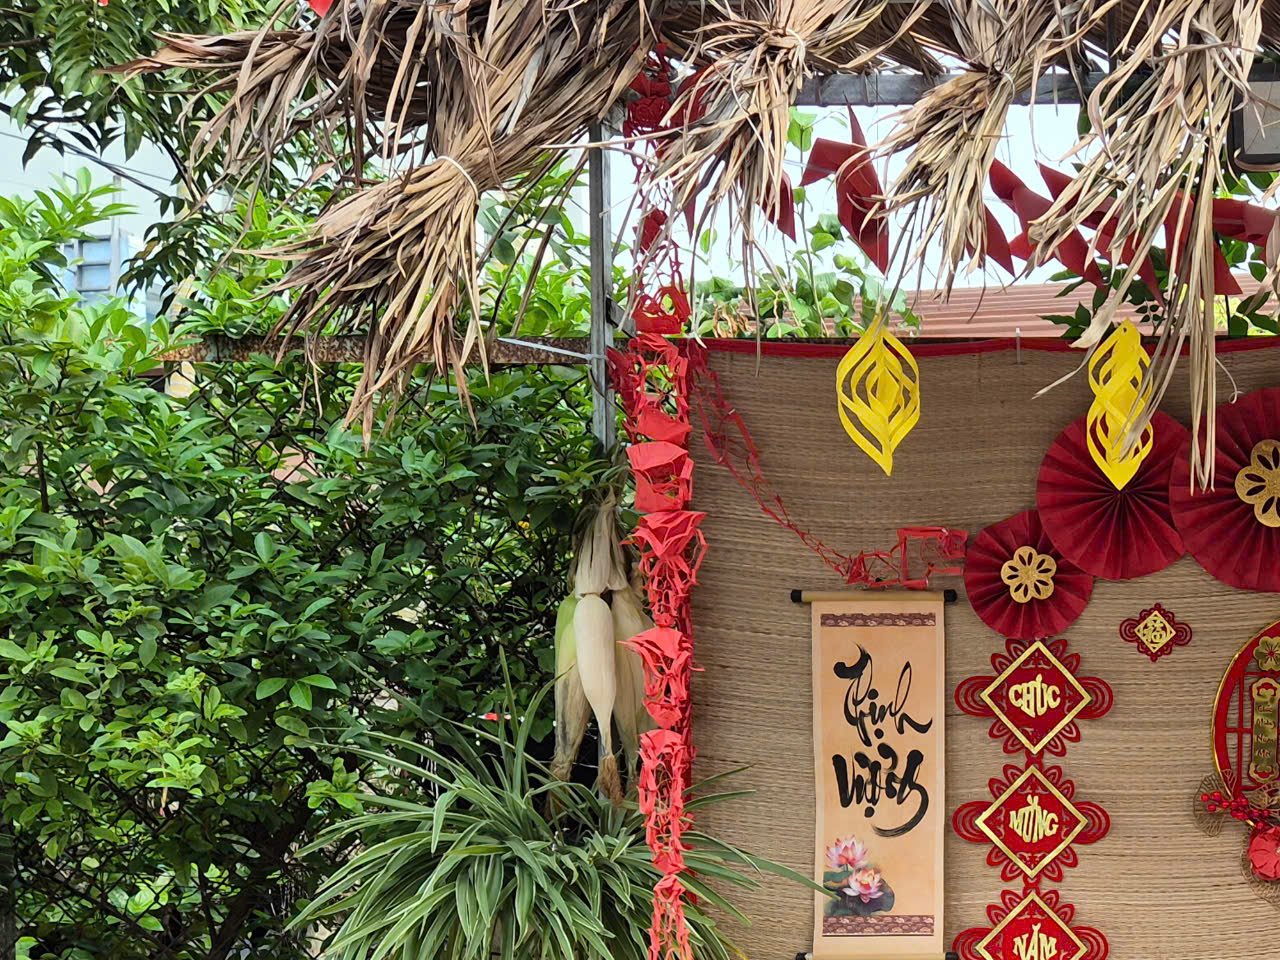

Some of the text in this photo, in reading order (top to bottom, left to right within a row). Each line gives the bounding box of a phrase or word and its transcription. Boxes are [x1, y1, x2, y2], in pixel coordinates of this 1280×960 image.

[833, 642, 933, 747] Thịnh
[1008, 674, 1061, 719] CHÚC
[1009, 794, 1059, 844] MỪNG
